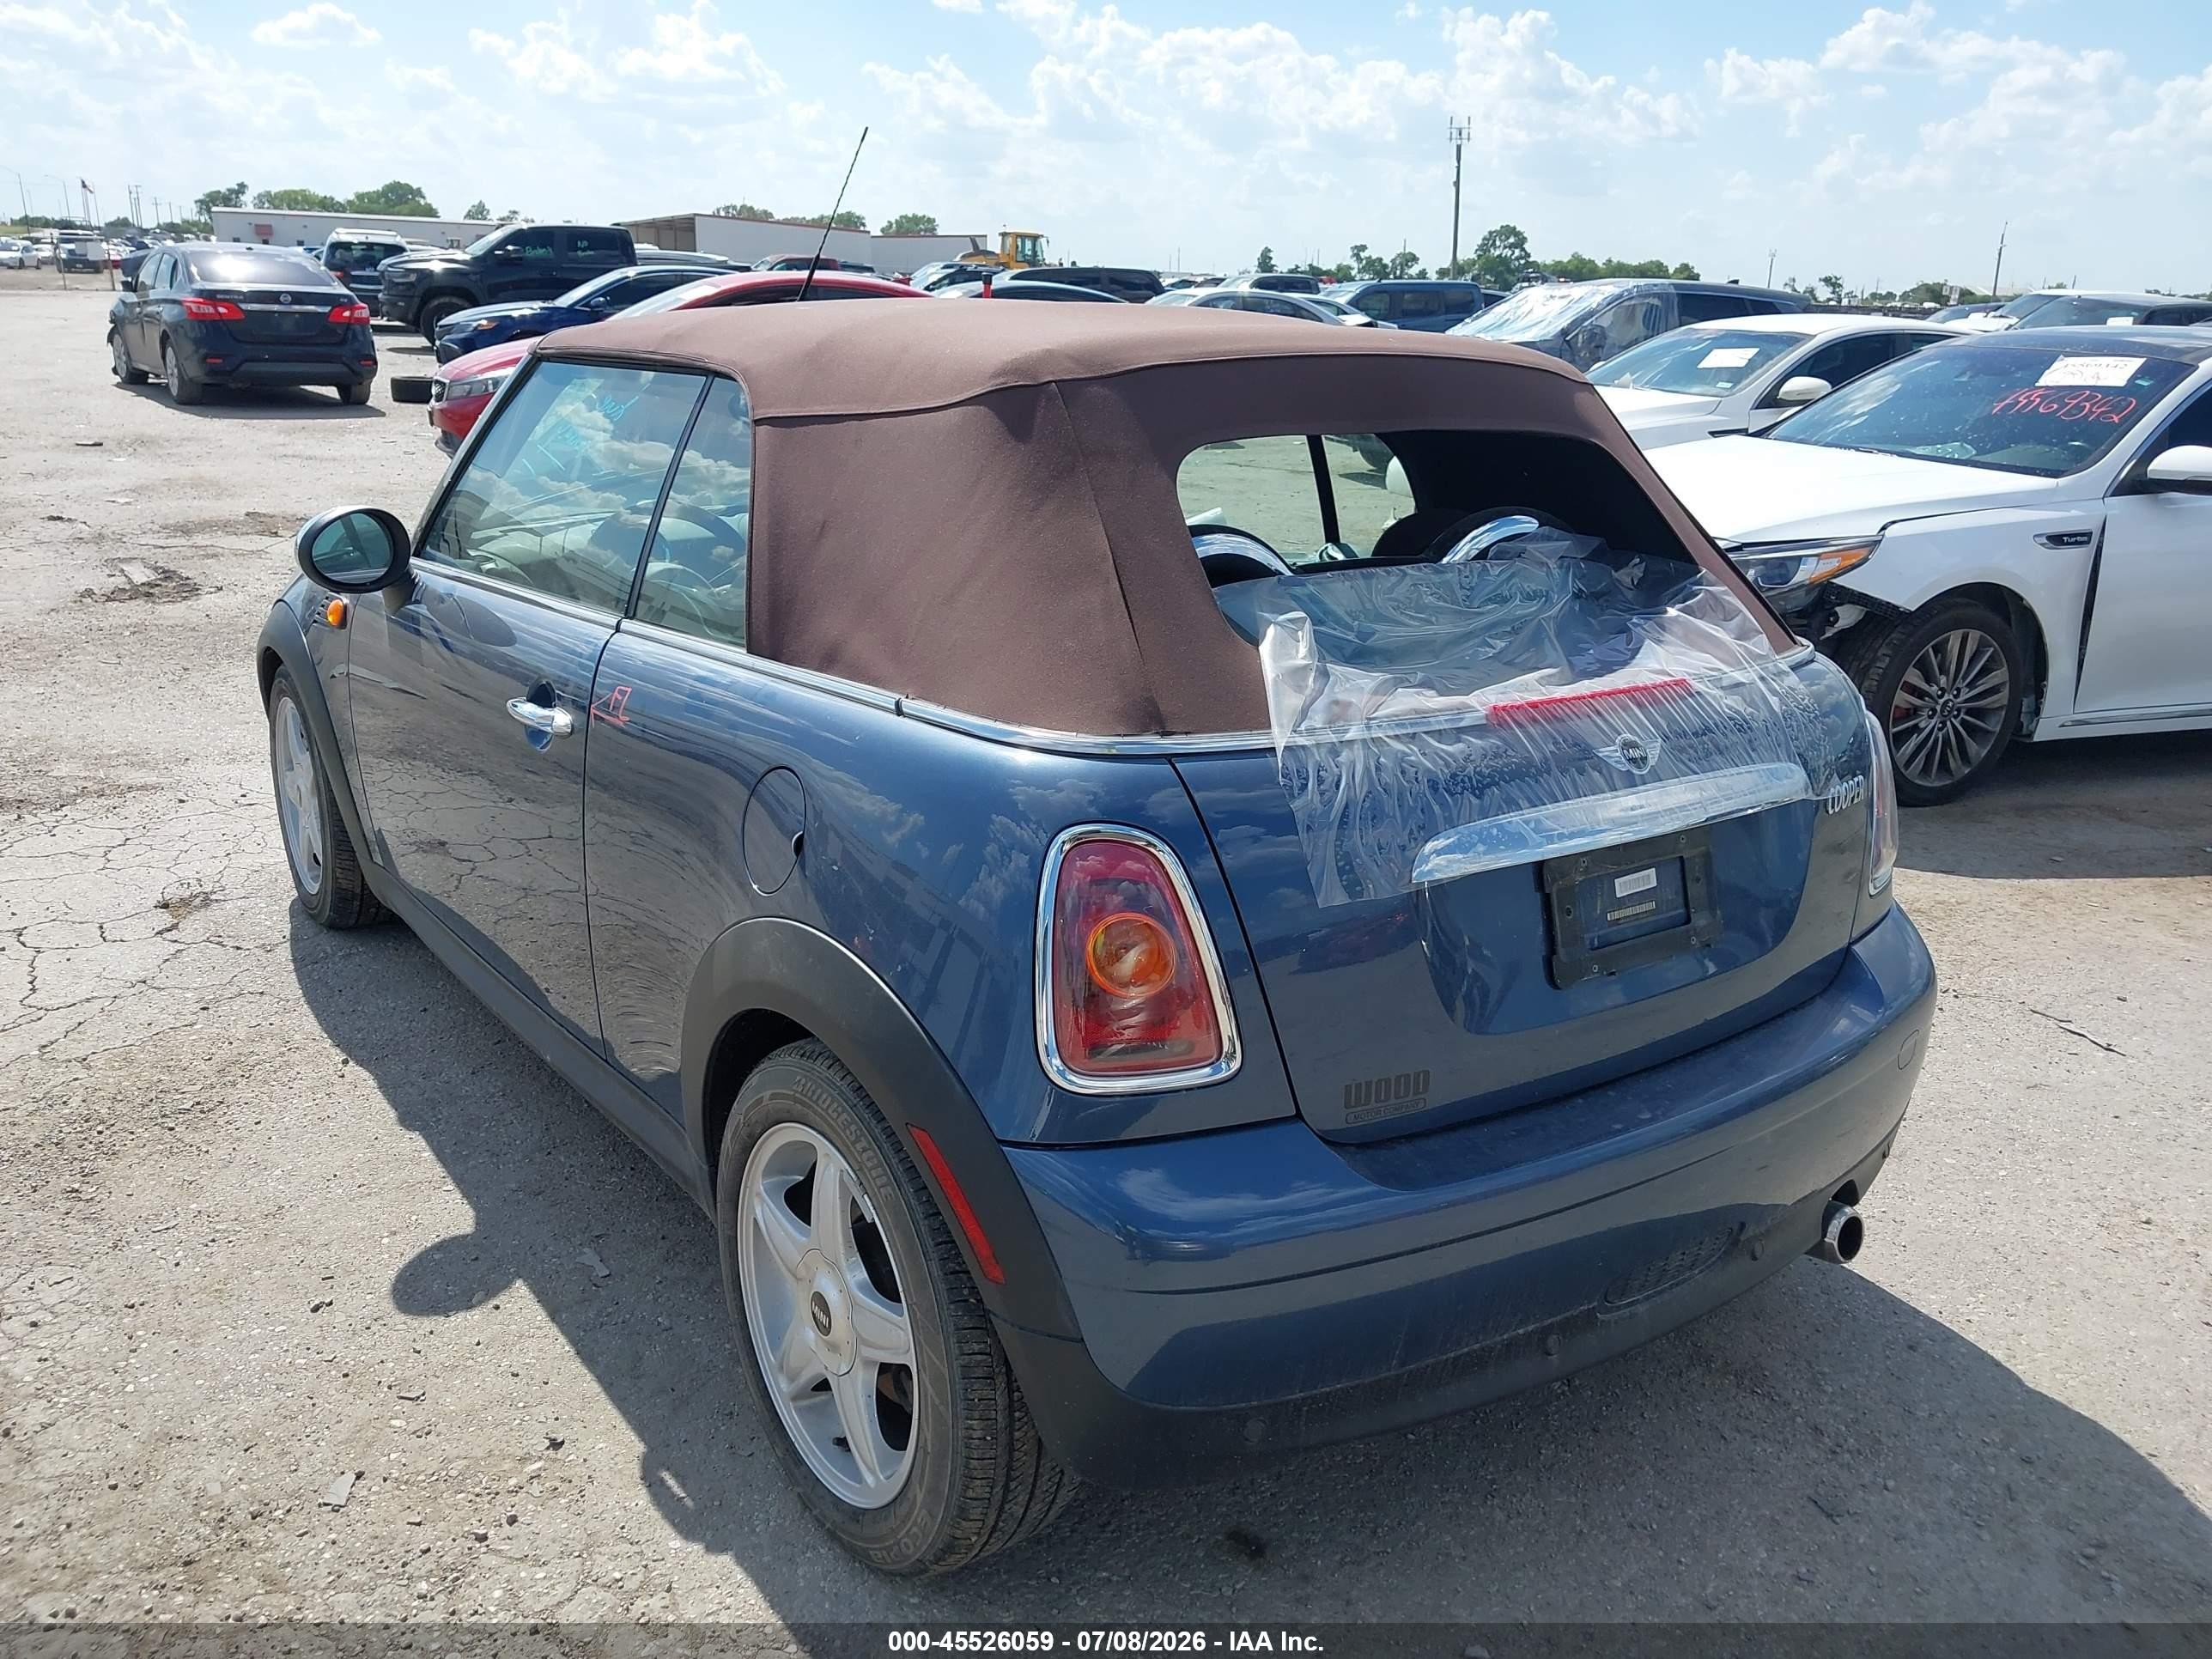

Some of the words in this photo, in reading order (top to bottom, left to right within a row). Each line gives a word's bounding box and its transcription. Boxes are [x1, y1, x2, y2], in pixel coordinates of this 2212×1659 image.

[1623, 746, 1647, 760] MINI
[1826, 774, 1865, 815] COOPER
[1344, 1069, 1431, 1109] WOOD
[1352, 1109, 1382, 1121] MOTOR
[1382, 1101, 1421, 1115] COMPANY
[793, 1075, 896, 1202] BRIDGESTONE
[811, 1300, 830, 1328] MINI
